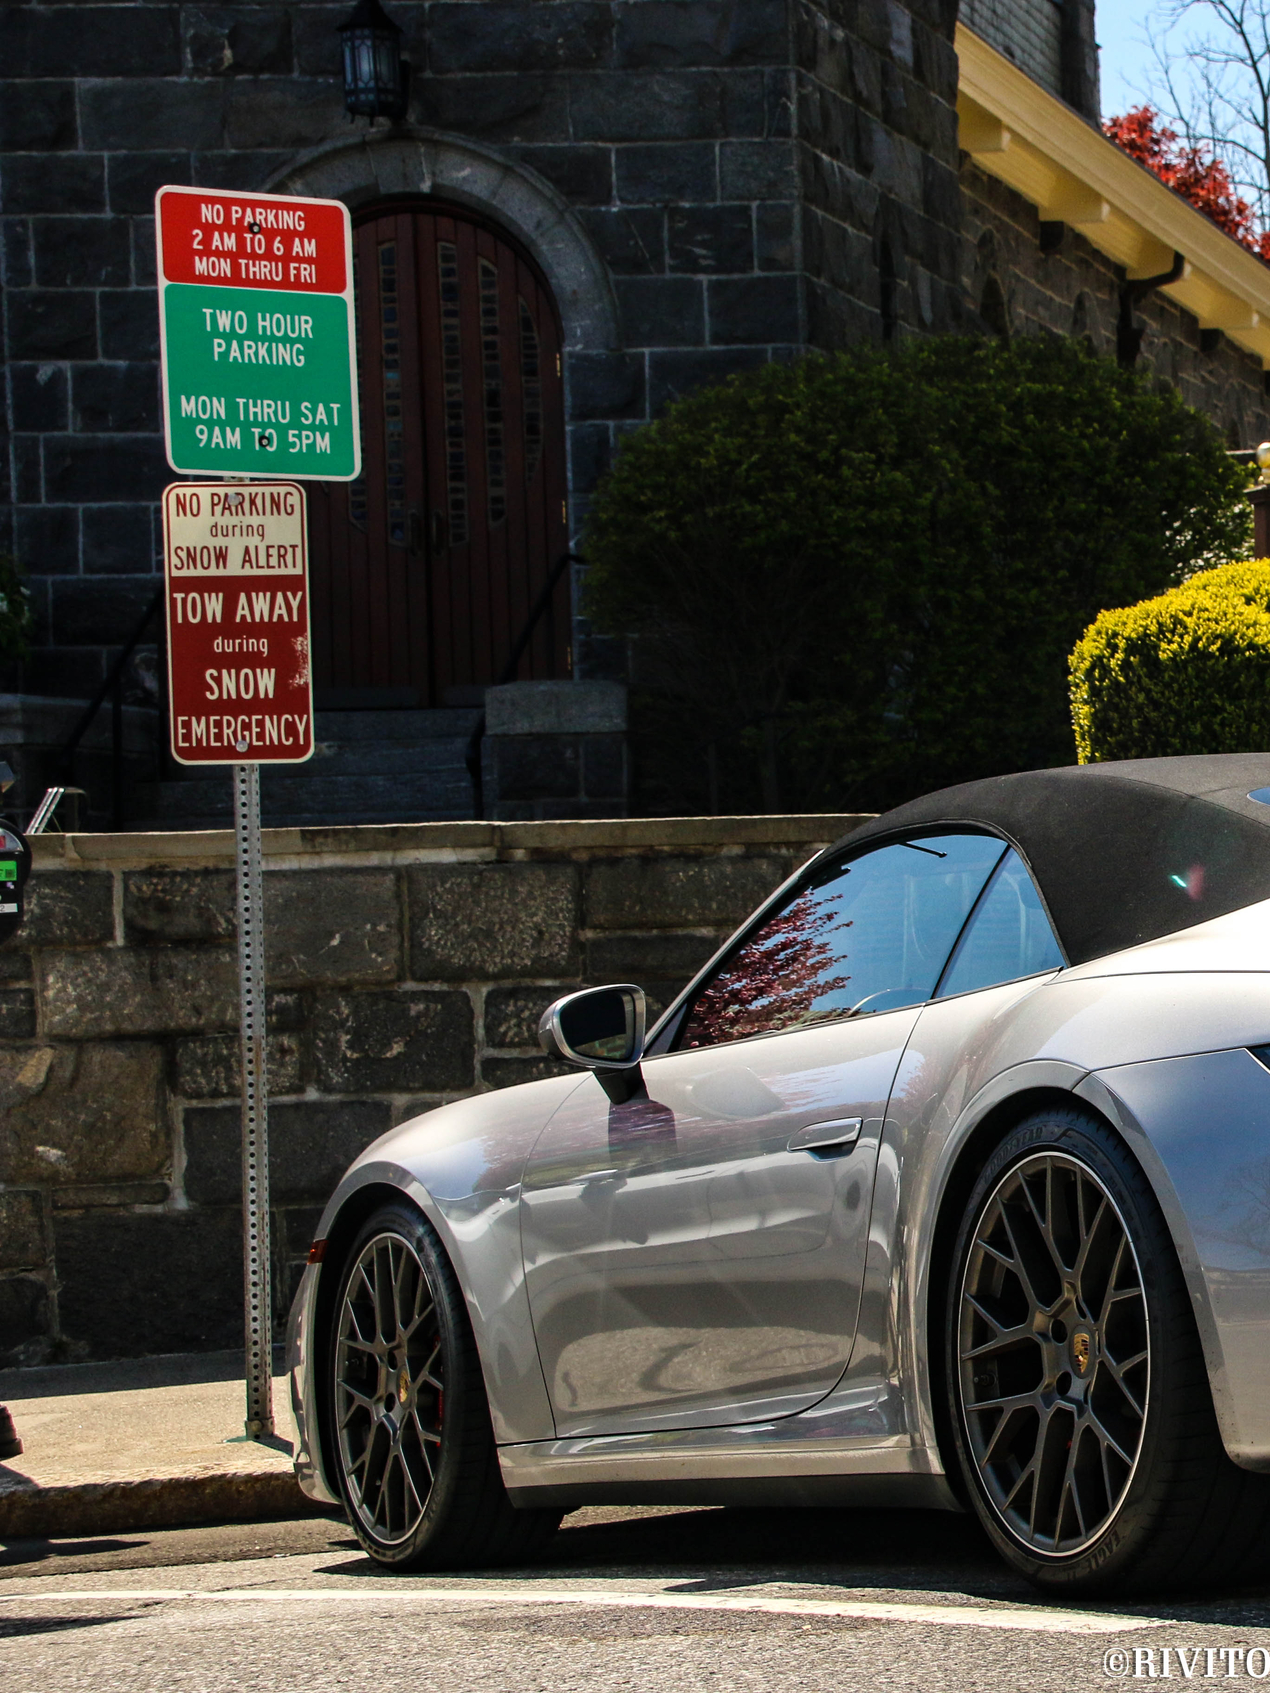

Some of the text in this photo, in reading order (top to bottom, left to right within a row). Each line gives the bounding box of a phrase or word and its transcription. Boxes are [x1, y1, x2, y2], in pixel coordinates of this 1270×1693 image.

[201, 204, 305, 231] NO PARKING
[192, 230, 317, 258] 2 AM TO 6 AM
[194, 256, 317, 284] MON THRU FRI
[202, 309, 313, 338] TWO HOUR
[213, 339, 305, 367] PARKING
[181, 395, 341, 426] MON THRU SAT
[195, 425, 331, 454] 9AM TO 5PM
[175, 492, 295, 517] NO PARKING
[210, 522, 265, 541] during
[174, 545, 299, 570] SNOW ALERT
[173, 591, 303, 623] TOW AWAY
[214, 636, 268, 657] during
[205, 668, 276, 700] SNOW
[177, 714, 308, 747] EMERGENCY
